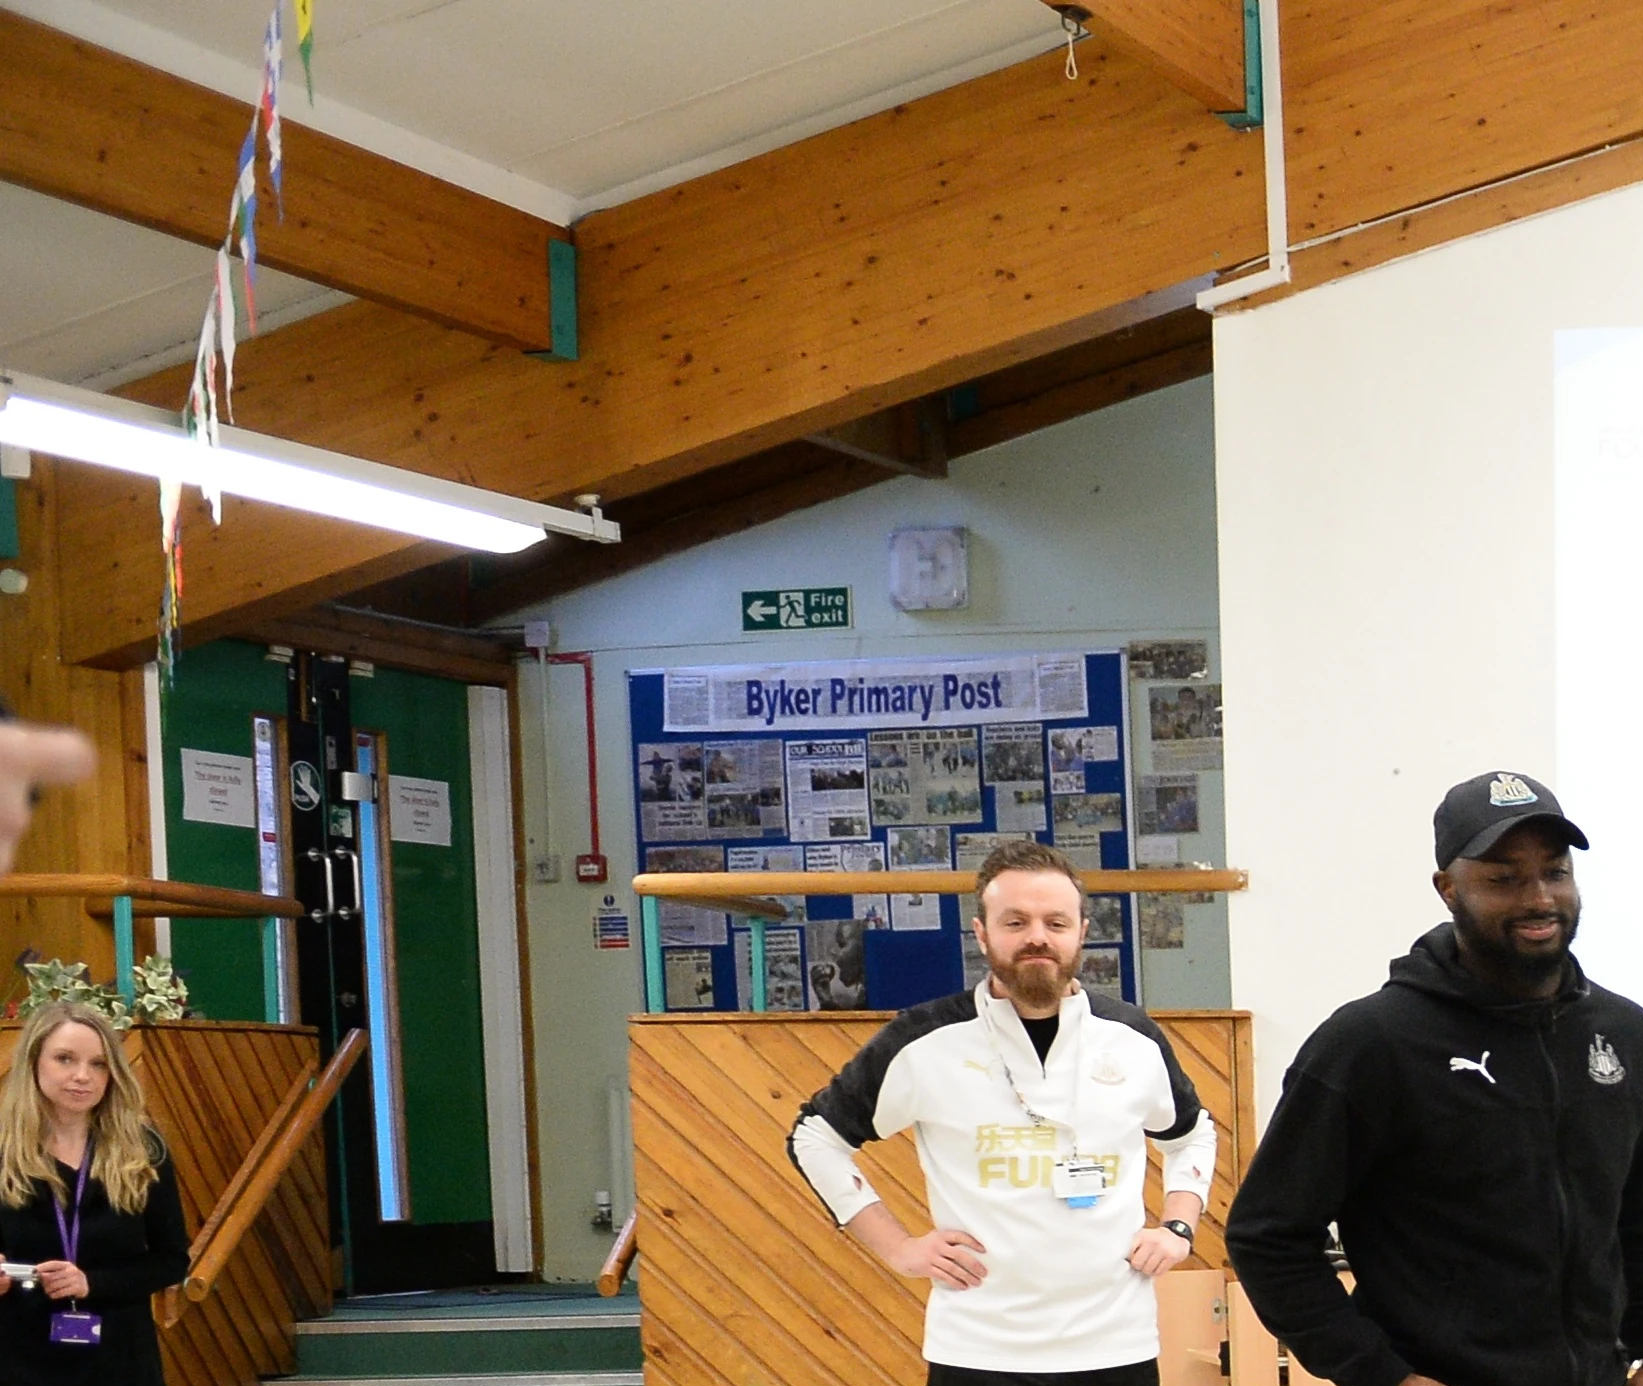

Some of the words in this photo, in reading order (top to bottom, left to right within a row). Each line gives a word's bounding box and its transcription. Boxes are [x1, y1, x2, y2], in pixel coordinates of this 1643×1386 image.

[810, 592, 845, 607] Fire
[811, 609, 844, 623] exit
[746, 679, 821, 726] Byker
[830, 677, 934, 722] Primary
[943, 673, 1003, 711] Post
